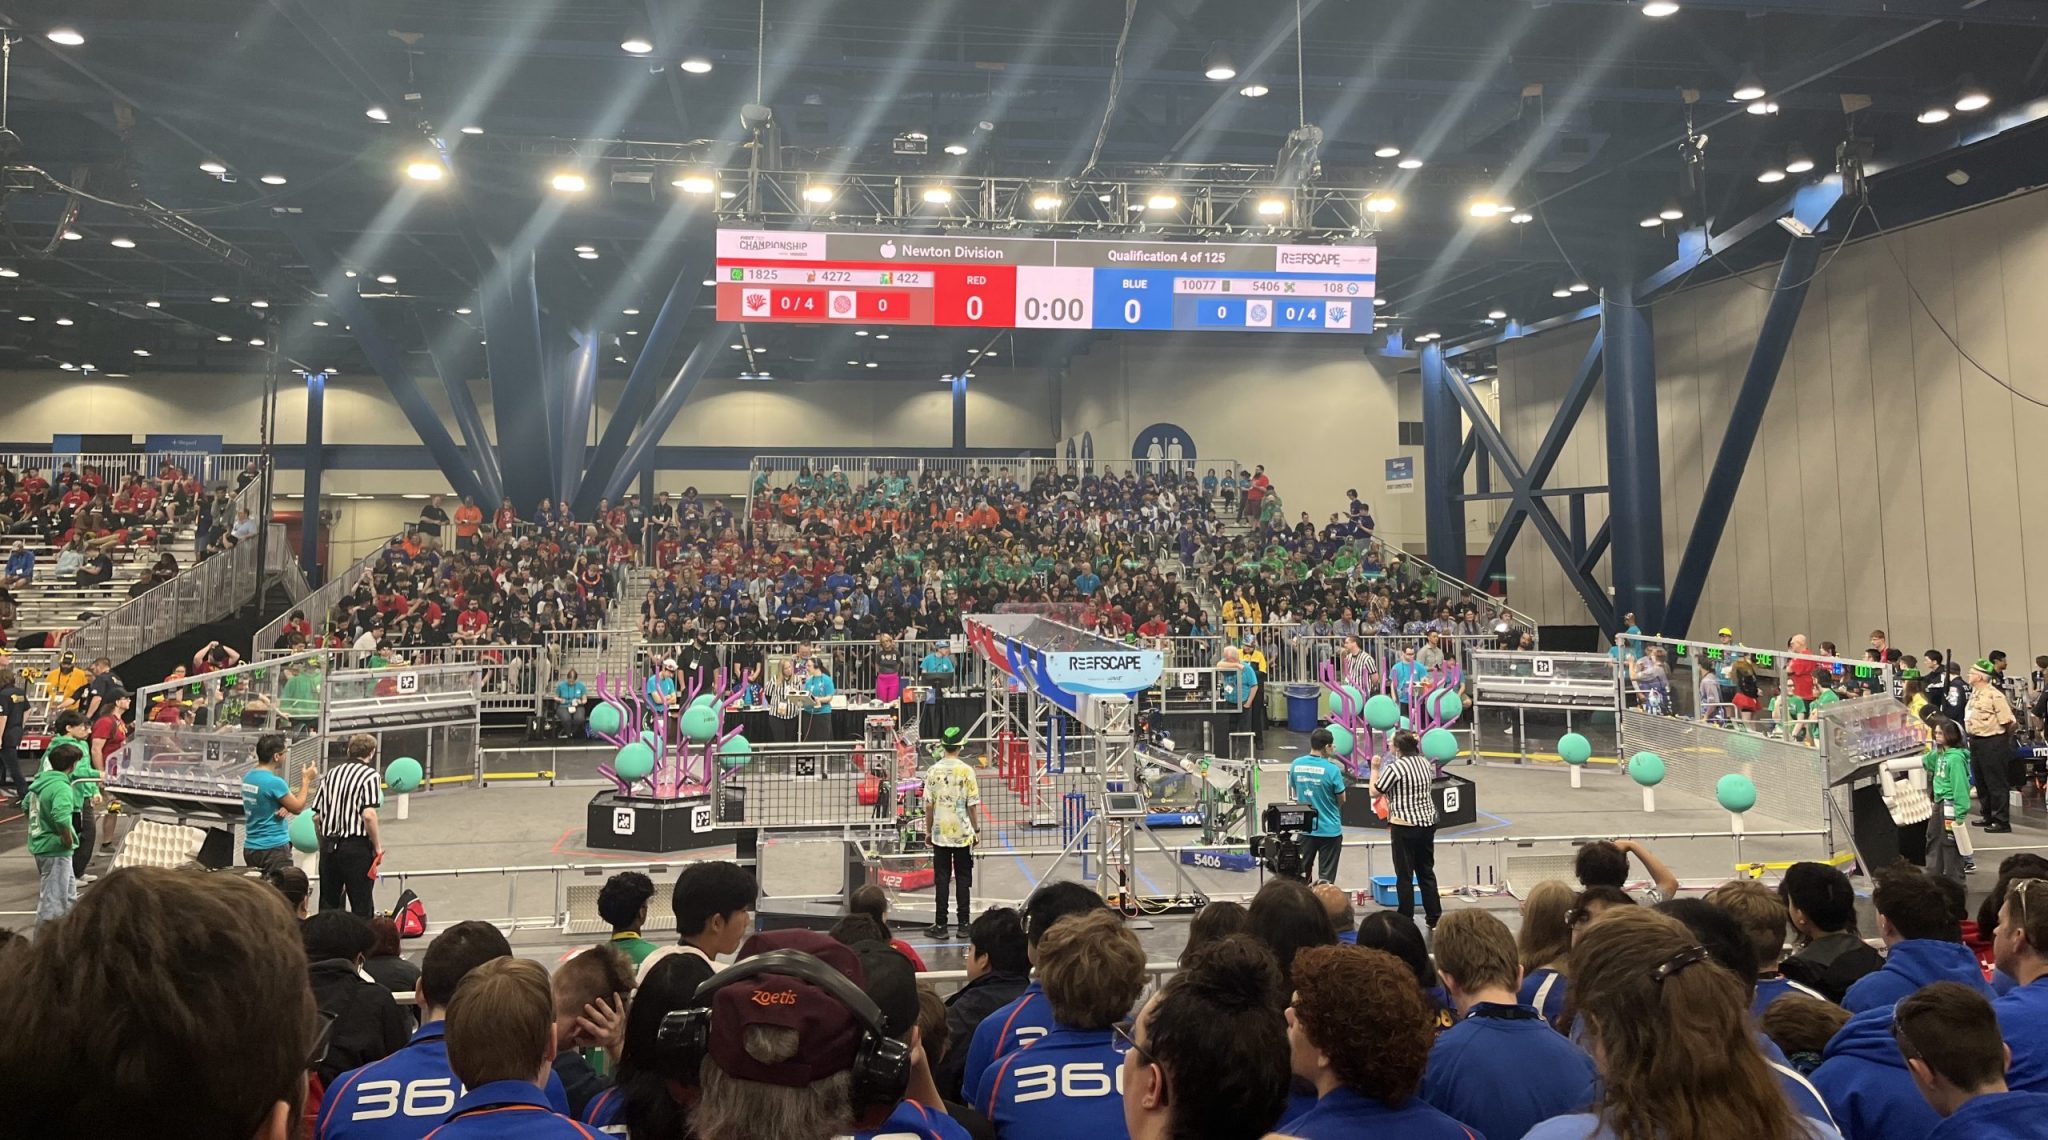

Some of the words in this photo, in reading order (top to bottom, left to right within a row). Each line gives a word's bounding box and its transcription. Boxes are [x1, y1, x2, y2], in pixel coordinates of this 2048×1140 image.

[740, 240, 808, 251] CHAMPIONSHIP
[902, 244, 951, 258] Newton
[955, 245, 1004, 259] Division
[1108, 250, 1177, 264] Qualification
[1179, 251, 1189, 262] 4
[1190, 251, 1203, 263] of
[1205, 252, 1226, 264] 125
[1281, 252, 1340, 265] REEFSCAPE
[748, 269, 778, 280] 1825
[821, 270, 851, 282] 4272
[897, 272, 919, 284] 422
[966, 276, 986, 285] RED
[1122, 279, 1148, 289] BLUE
[1182, 279, 1216, 291] 10077
[1252, 281, 1280, 292] 5406
[1323, 283, 1343, 293] 108
[781, 297, 790, 310] 0
[793, 297, 801, 311] /
[804, 298, 814, 311] 4
[878, 299, 888, 312] 0
[966, 295, 983, 321] 0
[1024, 297, 1084, 322] 0:00
[1123, 299, 1141, 324] 0
[1217, 306, 1227, 319] 0
[1286, 307, 1295, 320] 0
[1298, 307, 1306, 321] /
[1307, 308, 1317, 321] 4
[1069, 656, 1141, 670] REEFSCAPE
[1194, 853, 1221, 868] 5406
[882, 875, 903, 888] 422
[752, 989, 797, 1006] zoetis
[1014, 1063, 1125, 1103] 36
[352, 1077, 468, 1121] 36
